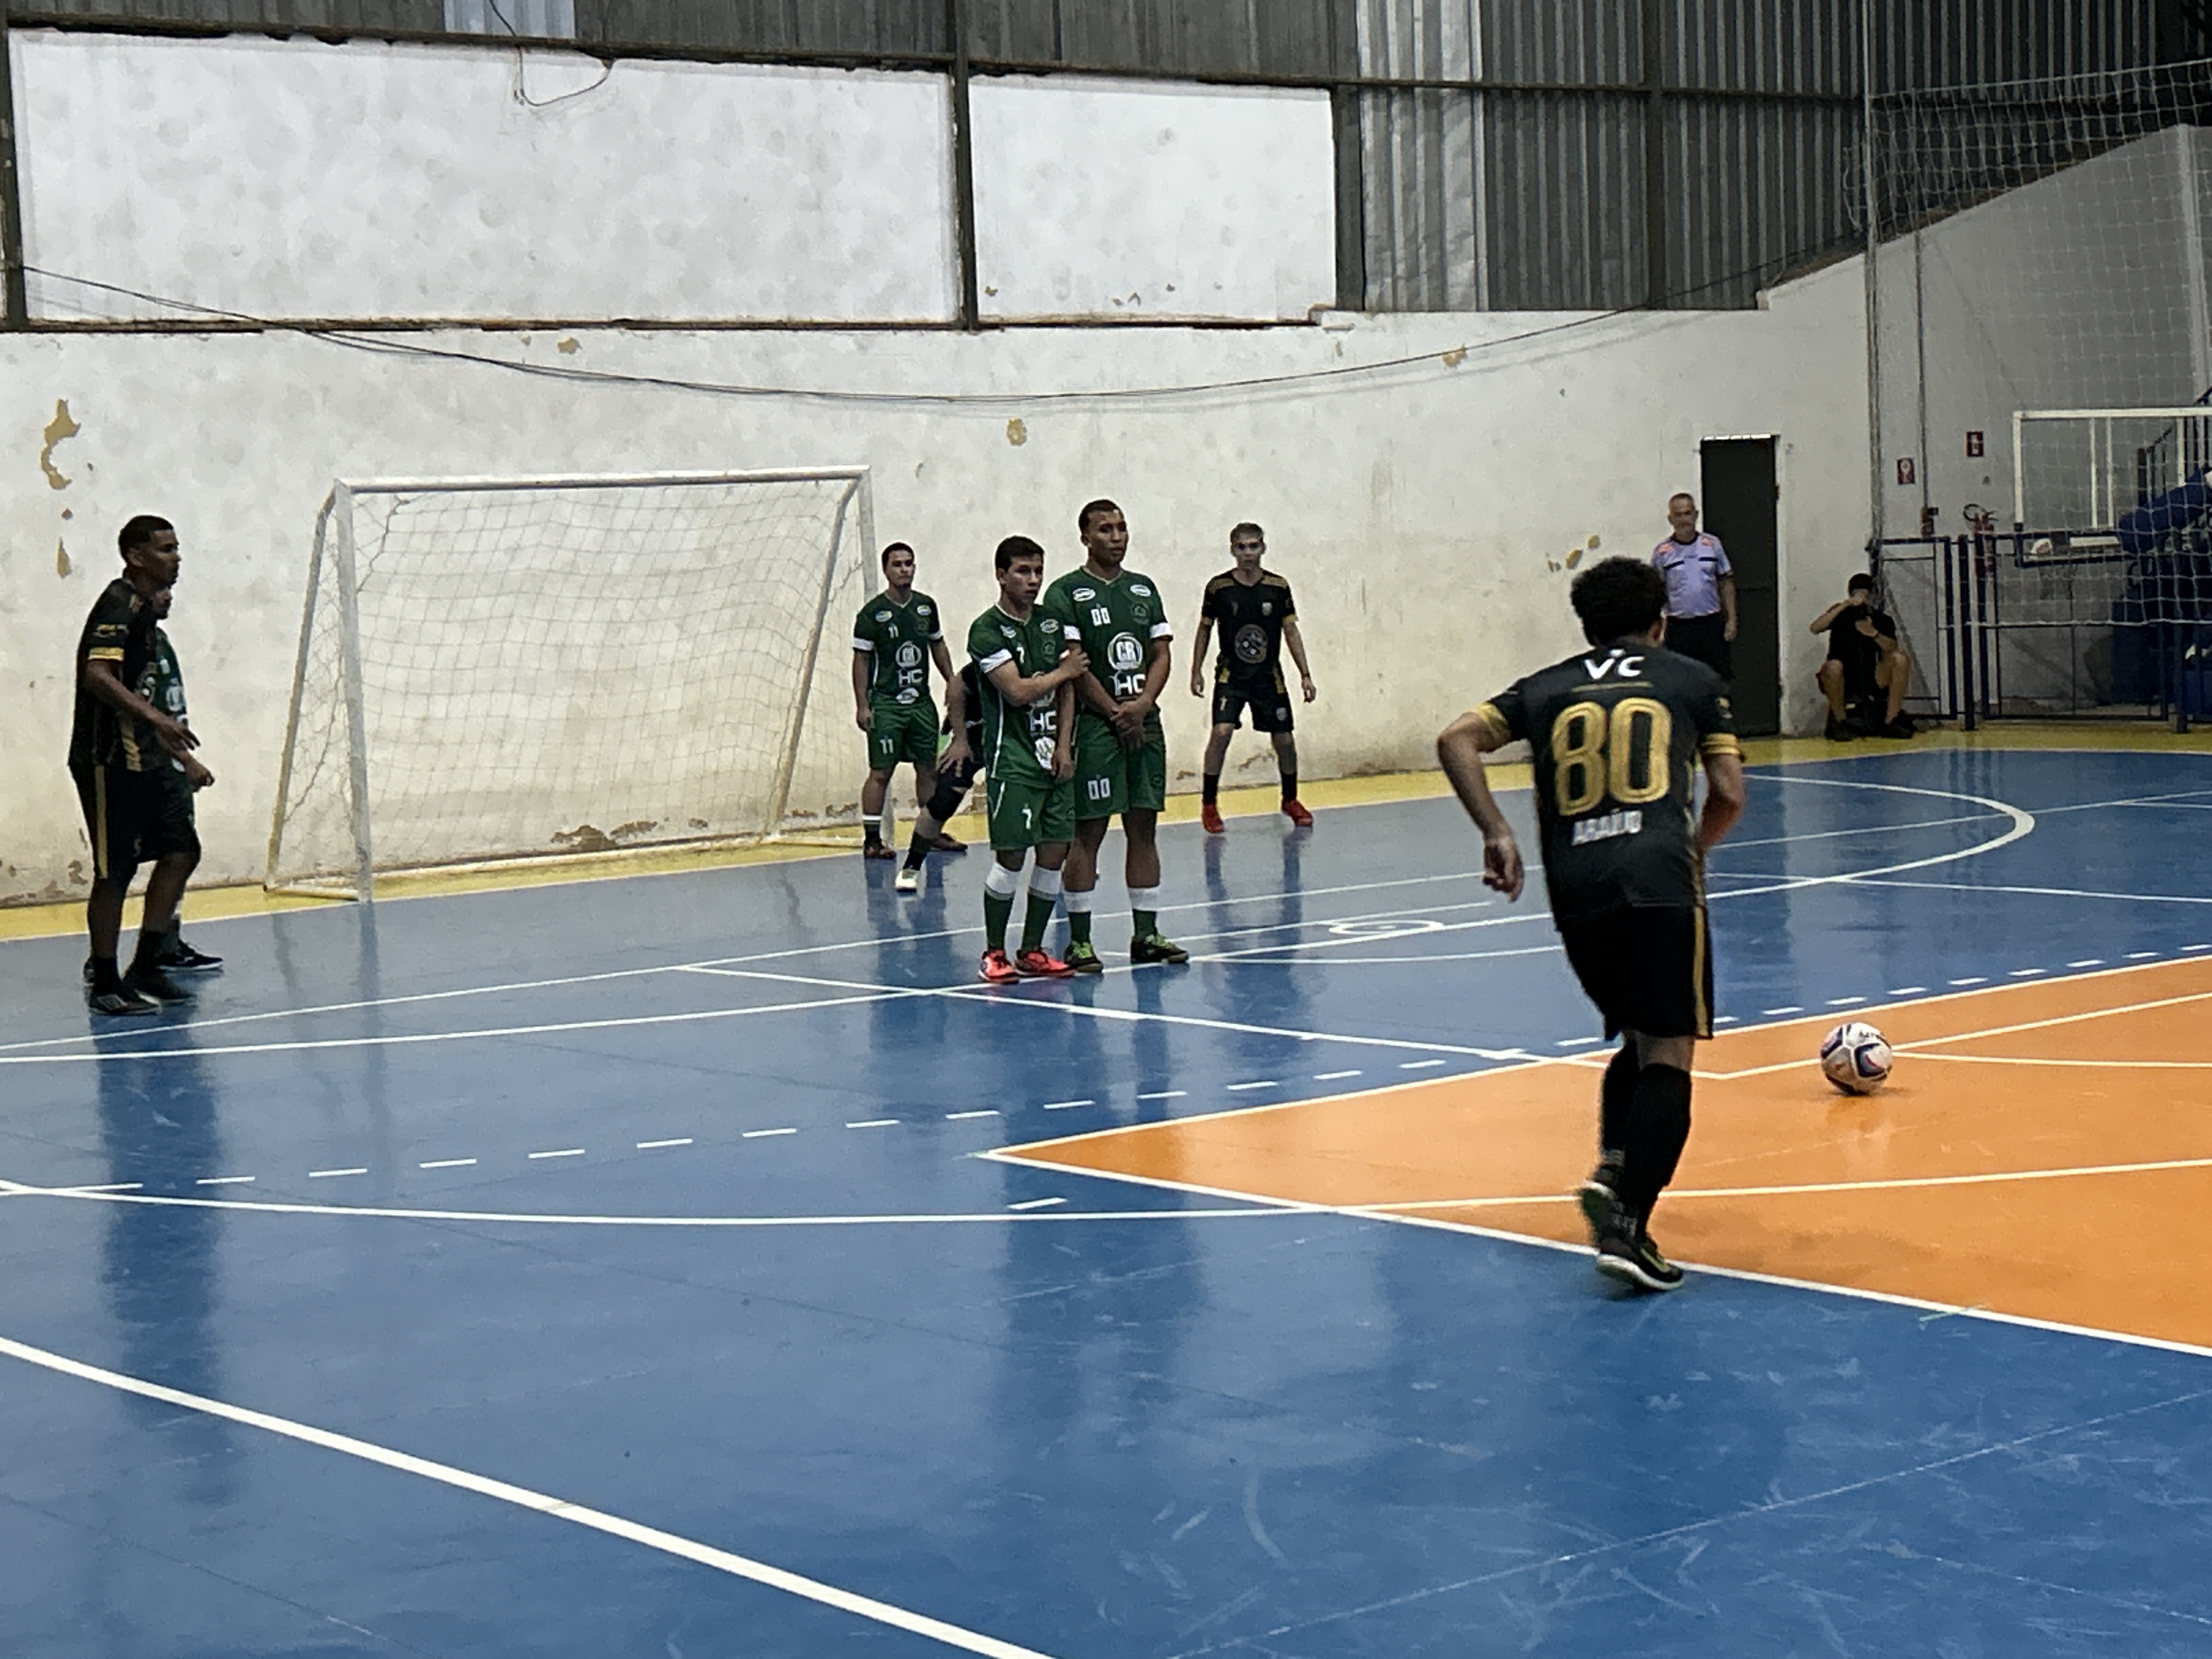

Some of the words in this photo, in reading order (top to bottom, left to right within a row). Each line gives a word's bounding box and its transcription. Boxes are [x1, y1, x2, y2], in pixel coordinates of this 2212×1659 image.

[1017, 647, 1025, 664] 7
[899, 669, 923, 685] HC
[1114, 674, 1146, 696] HC
[1030, 710, 1057, 731] HC
[881, 739, 893, 754] 11
[1552, 698, 1672, 816] 80
[1023, 808, 1032, 829] 7
